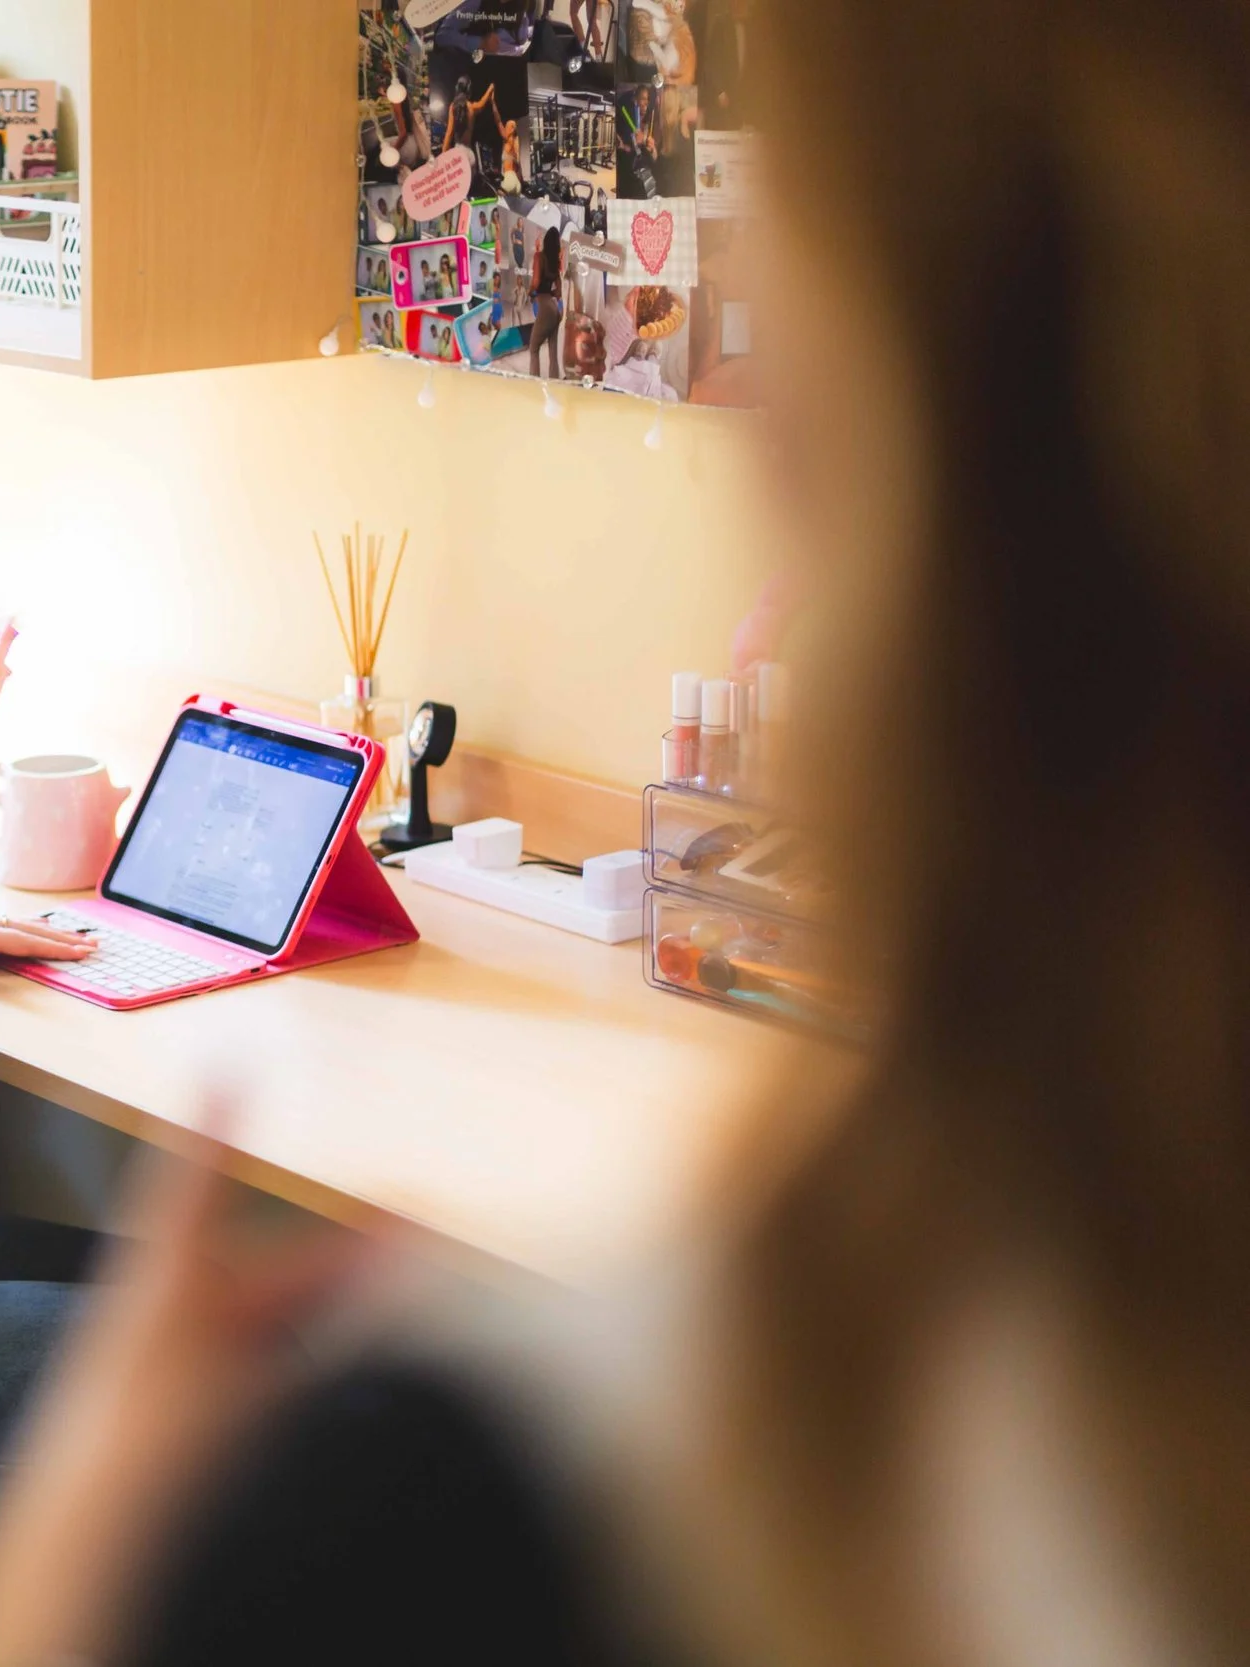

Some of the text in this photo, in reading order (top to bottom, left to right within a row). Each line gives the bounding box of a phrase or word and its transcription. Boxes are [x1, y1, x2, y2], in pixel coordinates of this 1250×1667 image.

[456, 10, 517, 22] Pretty girls study hard
[451, 156, 463, 167] the
[445, 182, 460, 194] love
